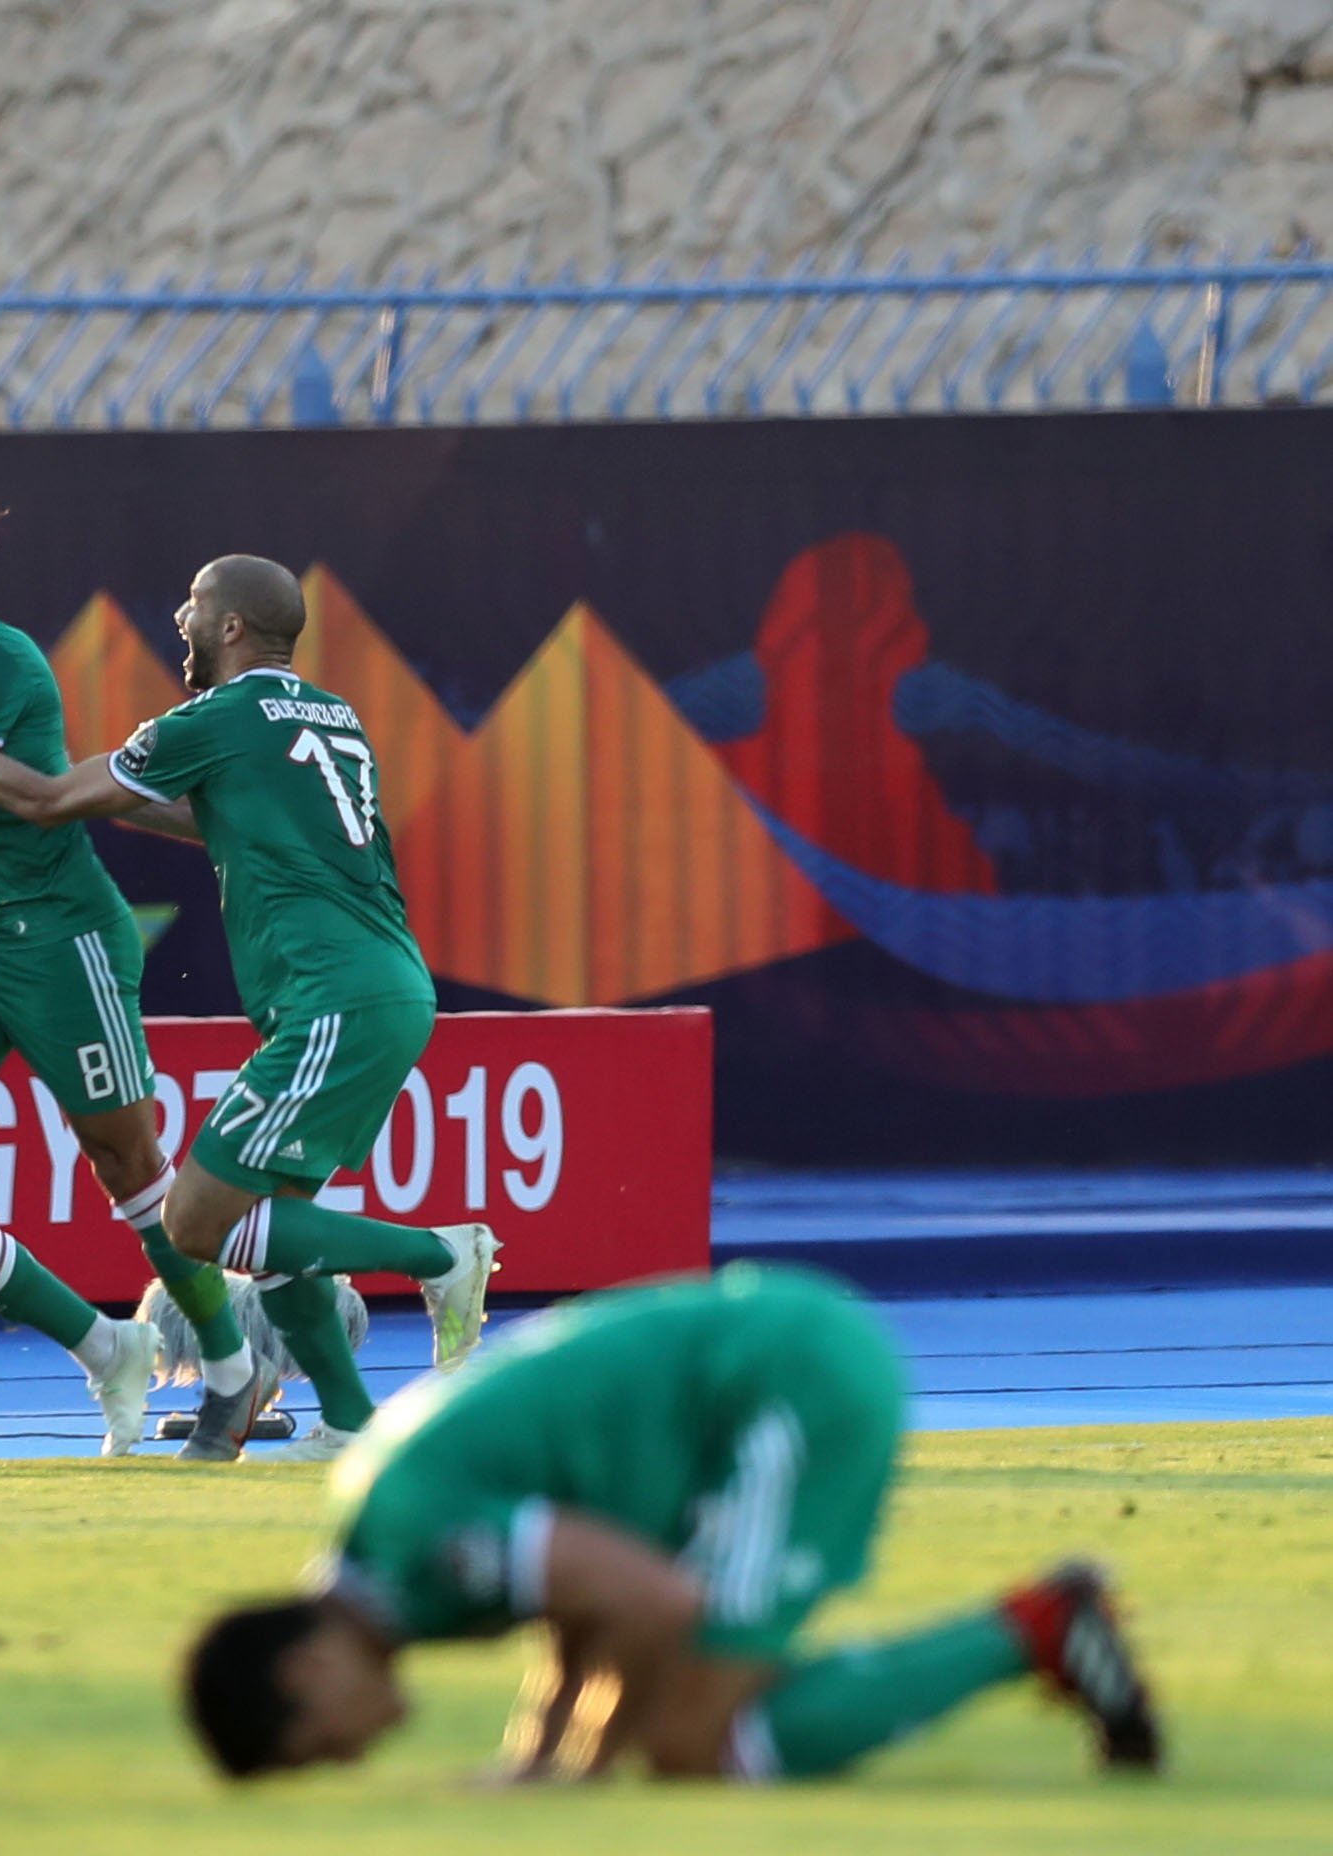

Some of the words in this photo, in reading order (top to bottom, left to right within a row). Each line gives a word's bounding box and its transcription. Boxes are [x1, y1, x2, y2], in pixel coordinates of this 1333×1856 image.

[259, 699, 363, 730] GUEDIOURA
[288, 728, 375, 844] 17
[77, 1043, 115, 1100] 8
[211, 1082, 265, 1136] 17
